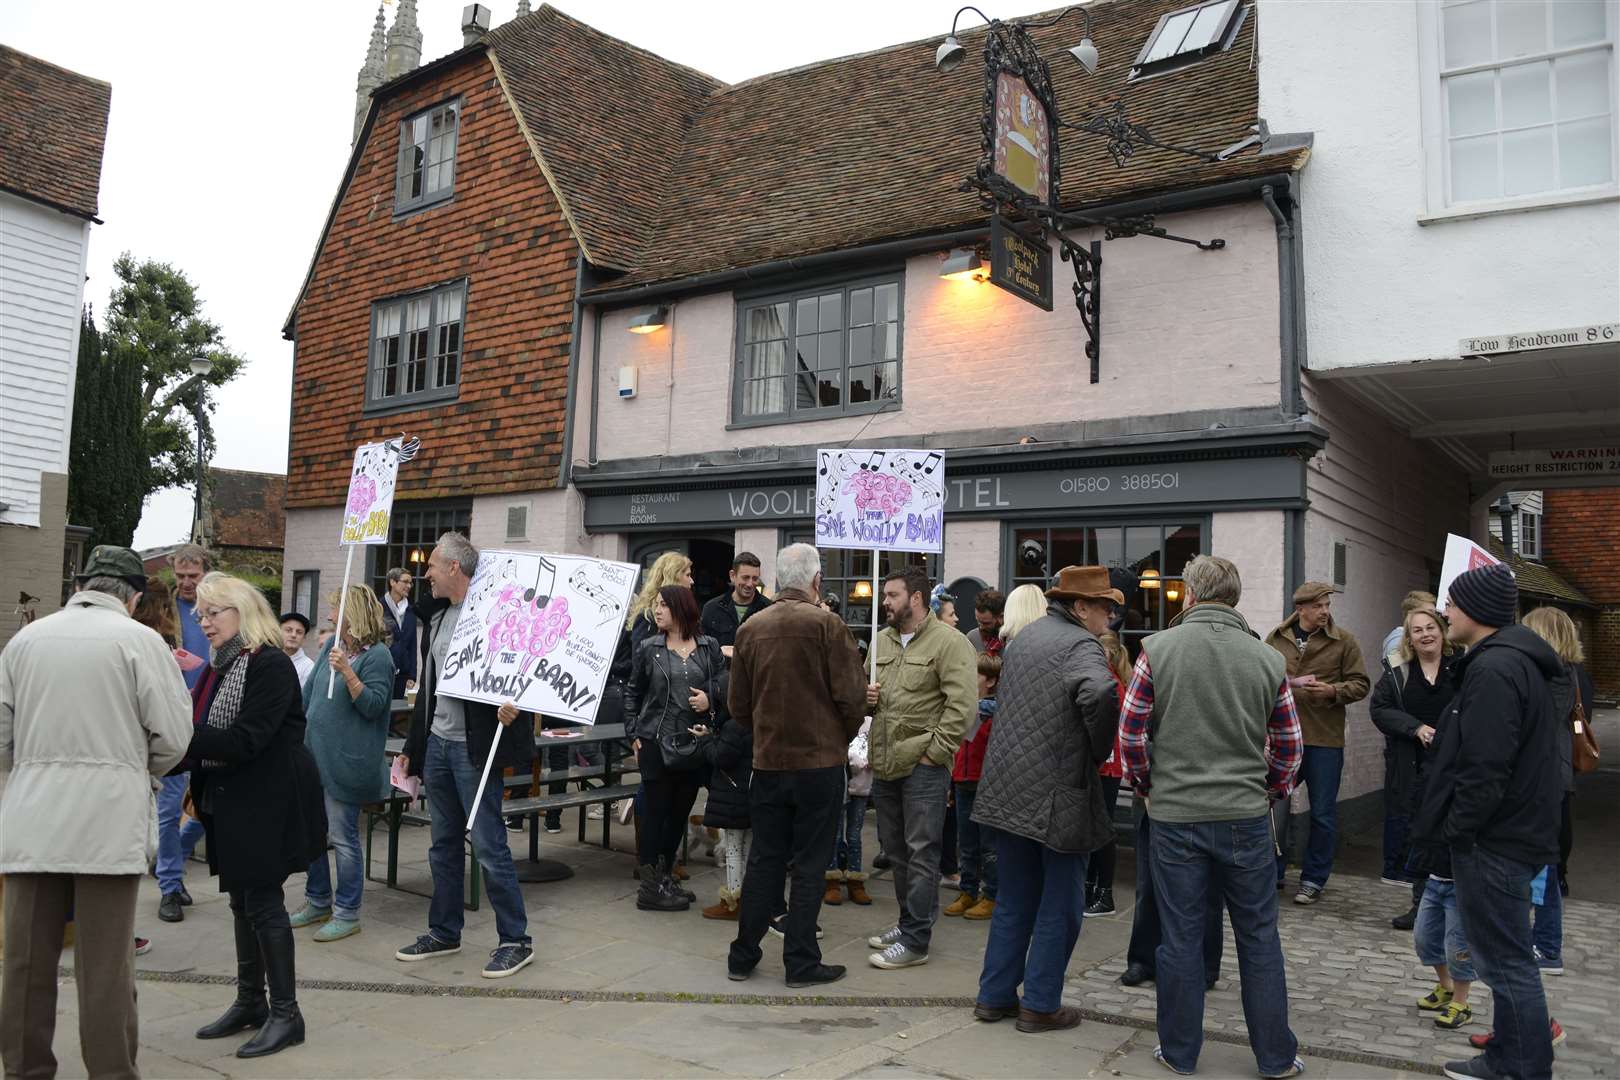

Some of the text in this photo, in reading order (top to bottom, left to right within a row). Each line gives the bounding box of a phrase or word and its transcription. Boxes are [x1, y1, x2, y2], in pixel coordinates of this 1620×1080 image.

[1468, 339, 1499, 352] Low
[1508, 332, 1579, 350] Headroom
[1551, 447, 1620, 460] WARNIN
[1492, 464, 1530, 474] HEIGHT
[1535, 461, 1603, 473] RESTRICTION
[1060, 472, 1179, 493] 01580 388501
[631, 492, 681, 504] RESTAURANT
[728, 488, 816, 517] WOOLP
[630, 505, 647, 515] BAR
[865, 510, 884, 521] THE
[630, 514, 657, 524] ROOMS
[816, 509, 942, 545] SAVE WOOLLY BARN
[443, 635, 484, 680] SAVE
[501, 652, 518, 664] THE
[470, 658, 597, 712] WOOLLY BARN!
